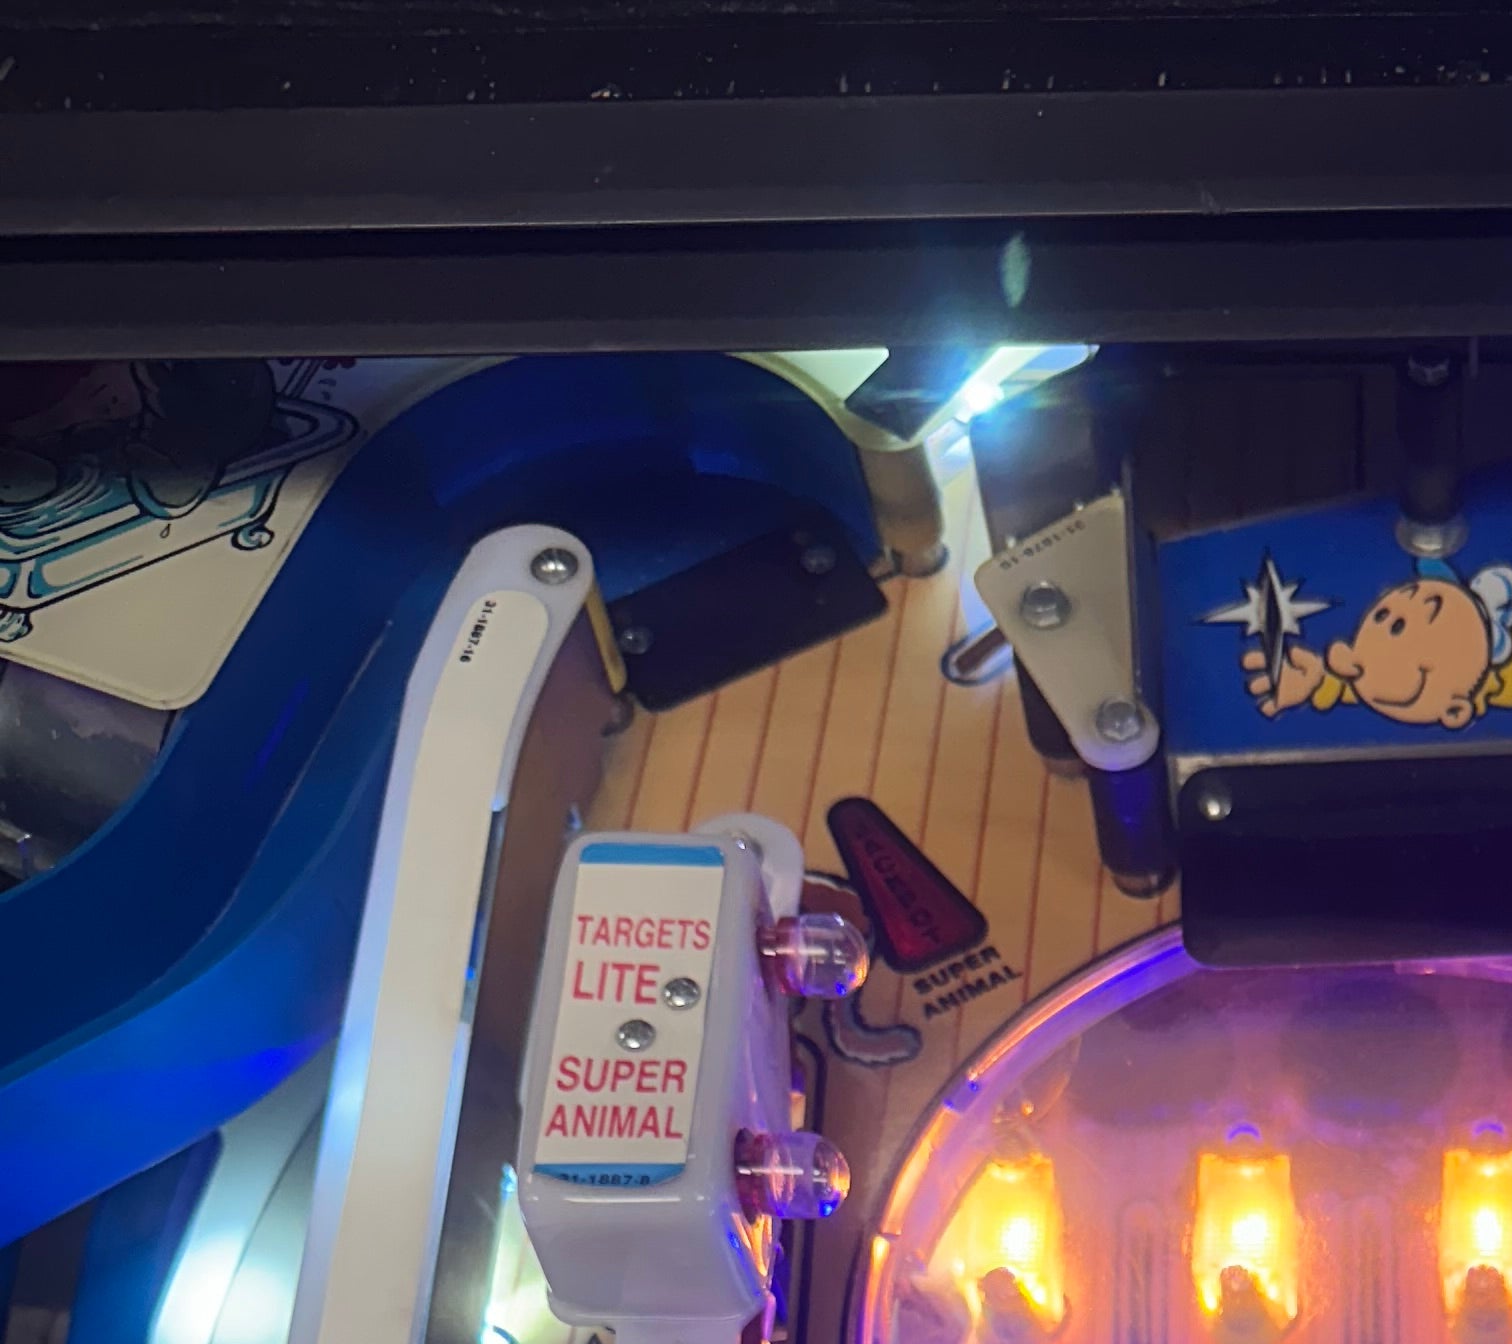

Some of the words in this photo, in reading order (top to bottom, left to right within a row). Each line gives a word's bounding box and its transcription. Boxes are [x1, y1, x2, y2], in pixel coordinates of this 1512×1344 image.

[576, 913, 712, 951] TARGETS
[572, 960, 661, 1005] LITE
[912, 945, 1001, 995] SUPER
[923, 965, 1024, 1021] ANIMAL
[555, 1055, 688, 1094] SUPER
[544, 1103, 684, 1140] ANIMAL
